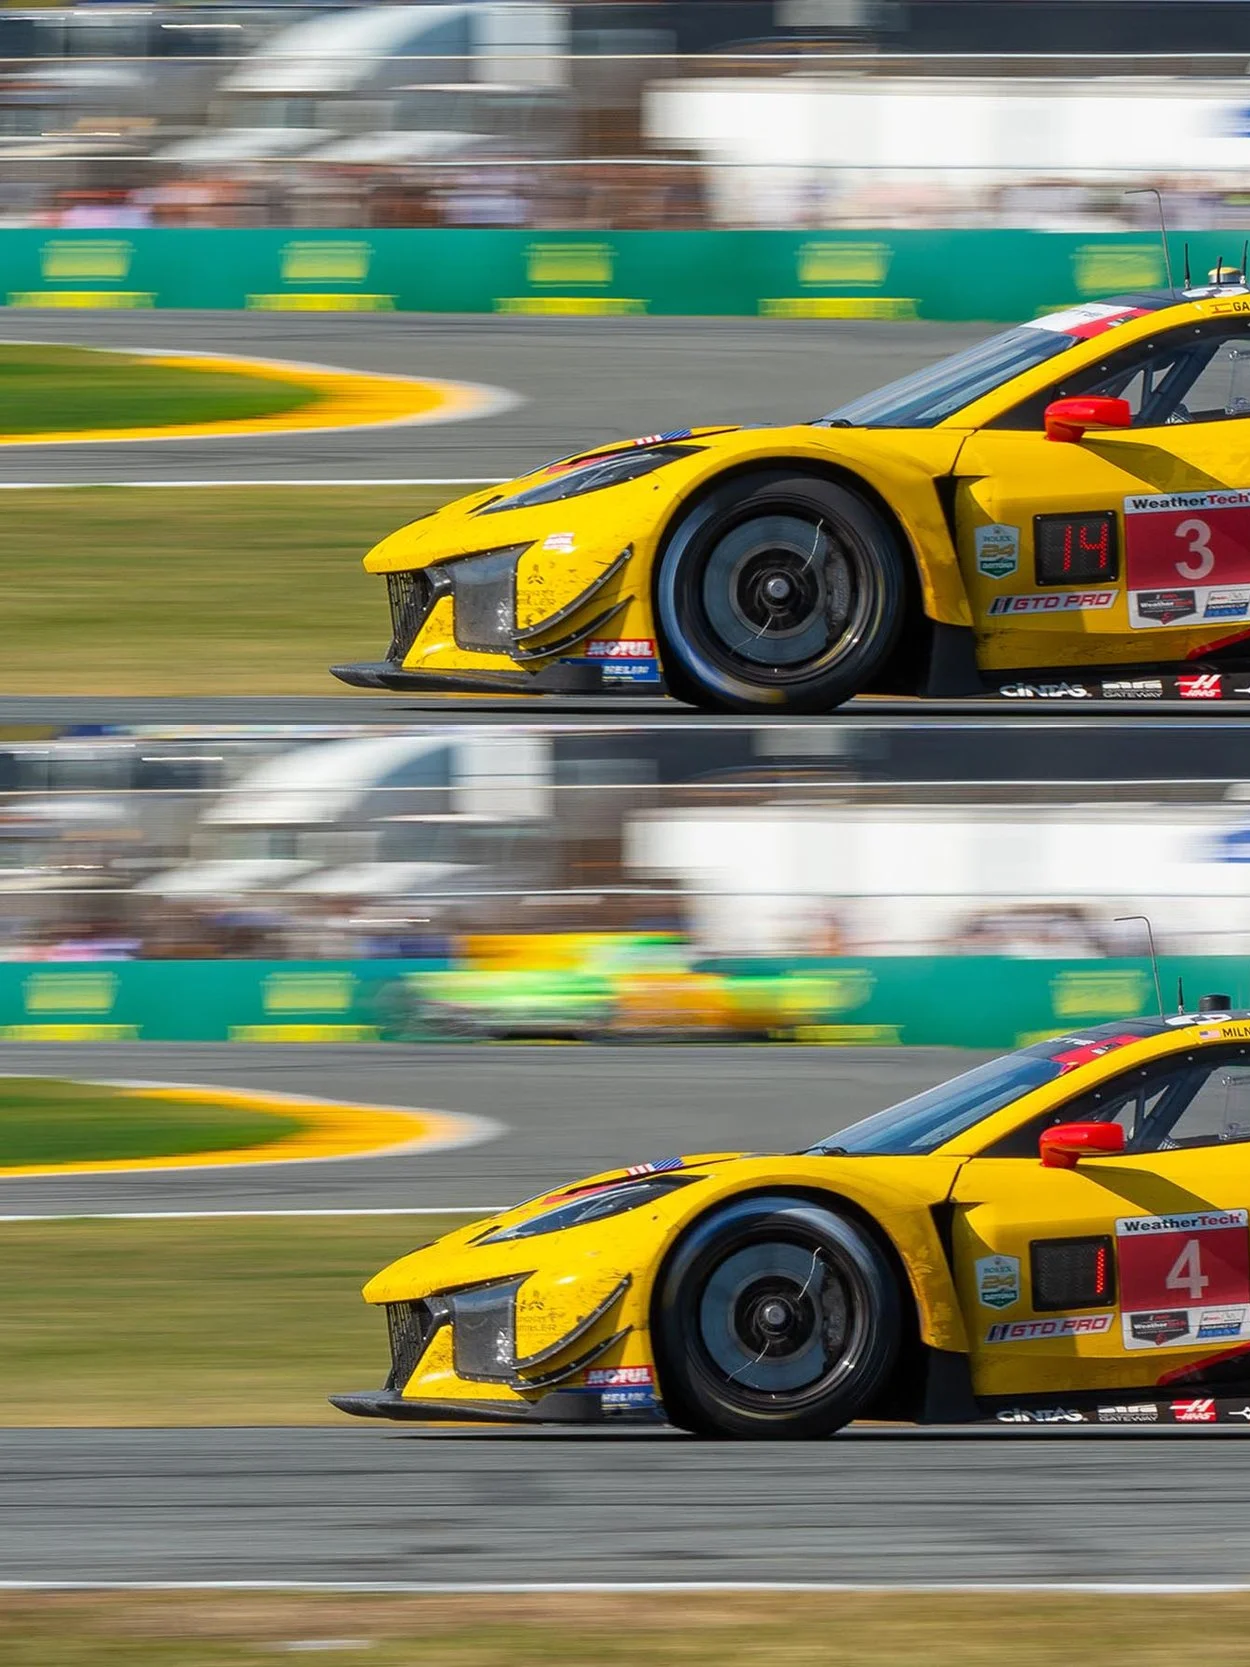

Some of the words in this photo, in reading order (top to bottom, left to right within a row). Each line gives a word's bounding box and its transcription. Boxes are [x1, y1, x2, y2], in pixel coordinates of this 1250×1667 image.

[1062, 521, 1108, 572] 14
[1174, 518, 1215, 581] 3
[1012, 594, 1063, 610] GTD
[1065, 592, 1112, 608] PRO
[587, 641, 653, 656] MOTUL
[1124, 1213, 1242, 1232] WeatherTech
[1165, 1239, 1209, 1299] 4
[1007, 1321, 1057, 1337] GTD
[1060, 1318, 1107, 1334] PRO
[587, 1368, 650, 1384] MOTUL
